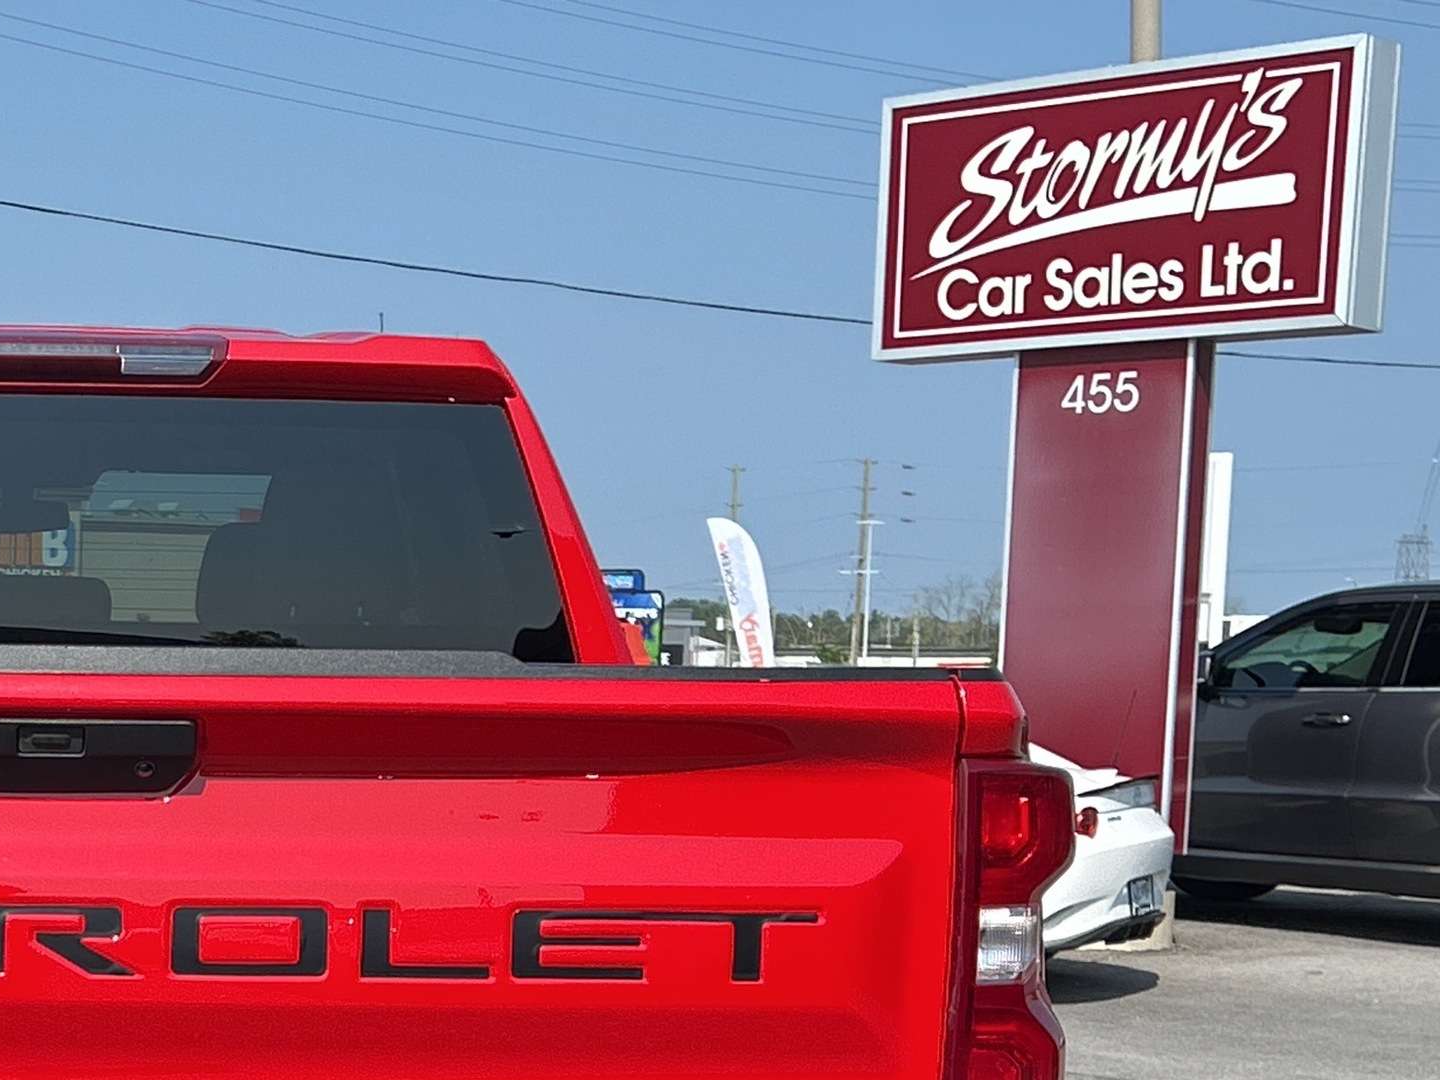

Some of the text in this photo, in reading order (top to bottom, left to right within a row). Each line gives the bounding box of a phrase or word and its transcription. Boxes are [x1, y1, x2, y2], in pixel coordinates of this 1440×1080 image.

[928, 68, 1304, 259] Stormy's
[937, 238, 1295, 321] Car Sales Ltd.
[1061, 371, 1139, 414] 455
